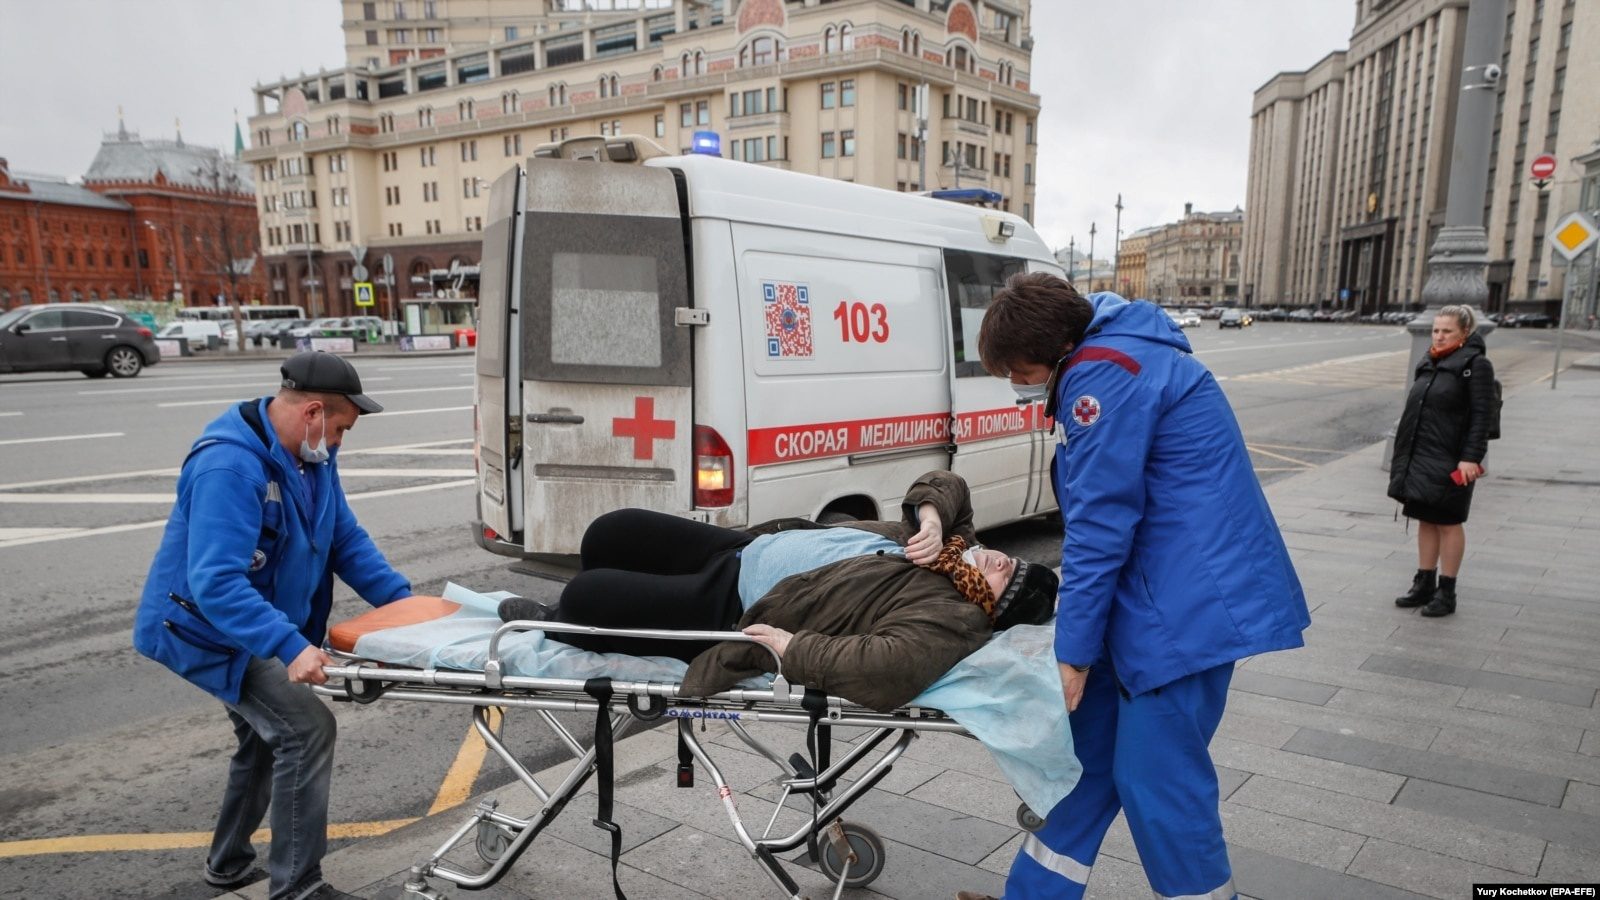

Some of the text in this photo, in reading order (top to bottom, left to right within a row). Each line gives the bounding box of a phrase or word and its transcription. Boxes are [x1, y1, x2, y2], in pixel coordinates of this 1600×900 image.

[834, 301, 889, 343] 103
[775, 411, 1025, 458] СКОРАЯ МЕДИЦИНСКАЯ ПОМОЩЬ
